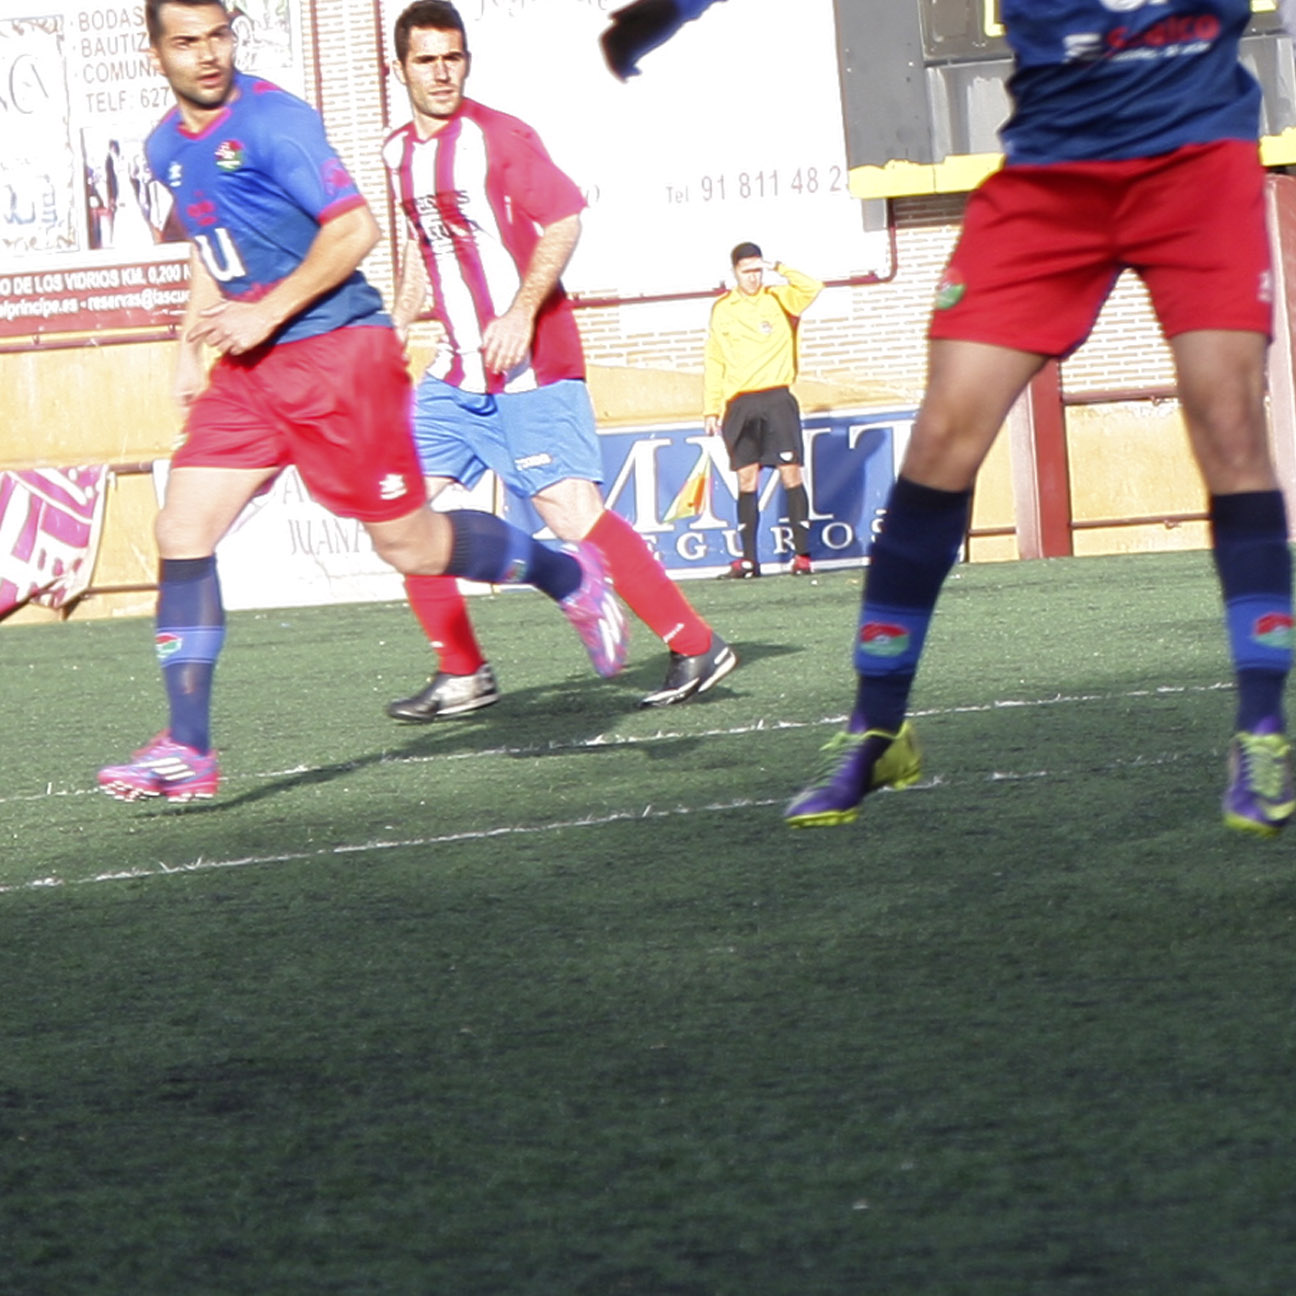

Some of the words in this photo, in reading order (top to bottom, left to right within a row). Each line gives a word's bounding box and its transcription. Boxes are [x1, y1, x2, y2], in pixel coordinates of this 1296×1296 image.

[79, 7, 145, 32] BODAS
[81, 32, 148, 58] BAUTIZ
[738, 170, 780, 200] 811
[791, 167, 820, 194] 48
[34, 273, 64, 294] LOS
[64, 269, 121, 291] VIDRIOS
